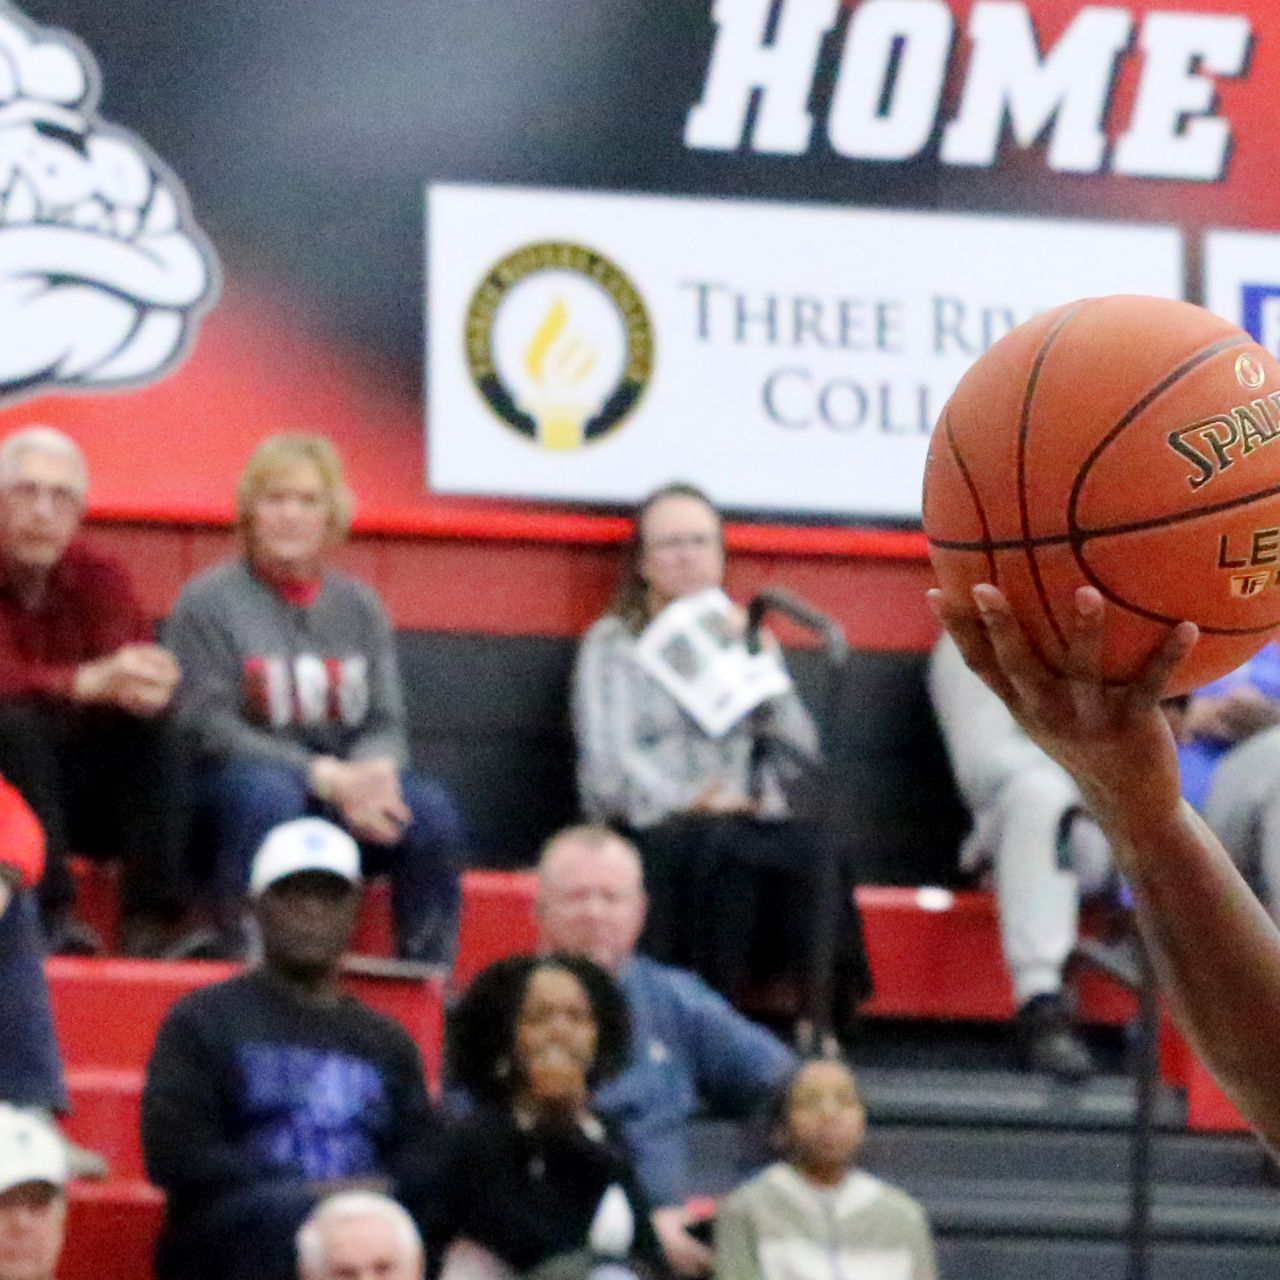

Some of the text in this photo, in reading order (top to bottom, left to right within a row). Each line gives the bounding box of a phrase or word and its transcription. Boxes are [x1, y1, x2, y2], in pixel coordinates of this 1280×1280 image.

[684, 0, 1256, 183] HOME
[678, 280, 905, 352] THREE
[760, 366, 936, 435] COLL
